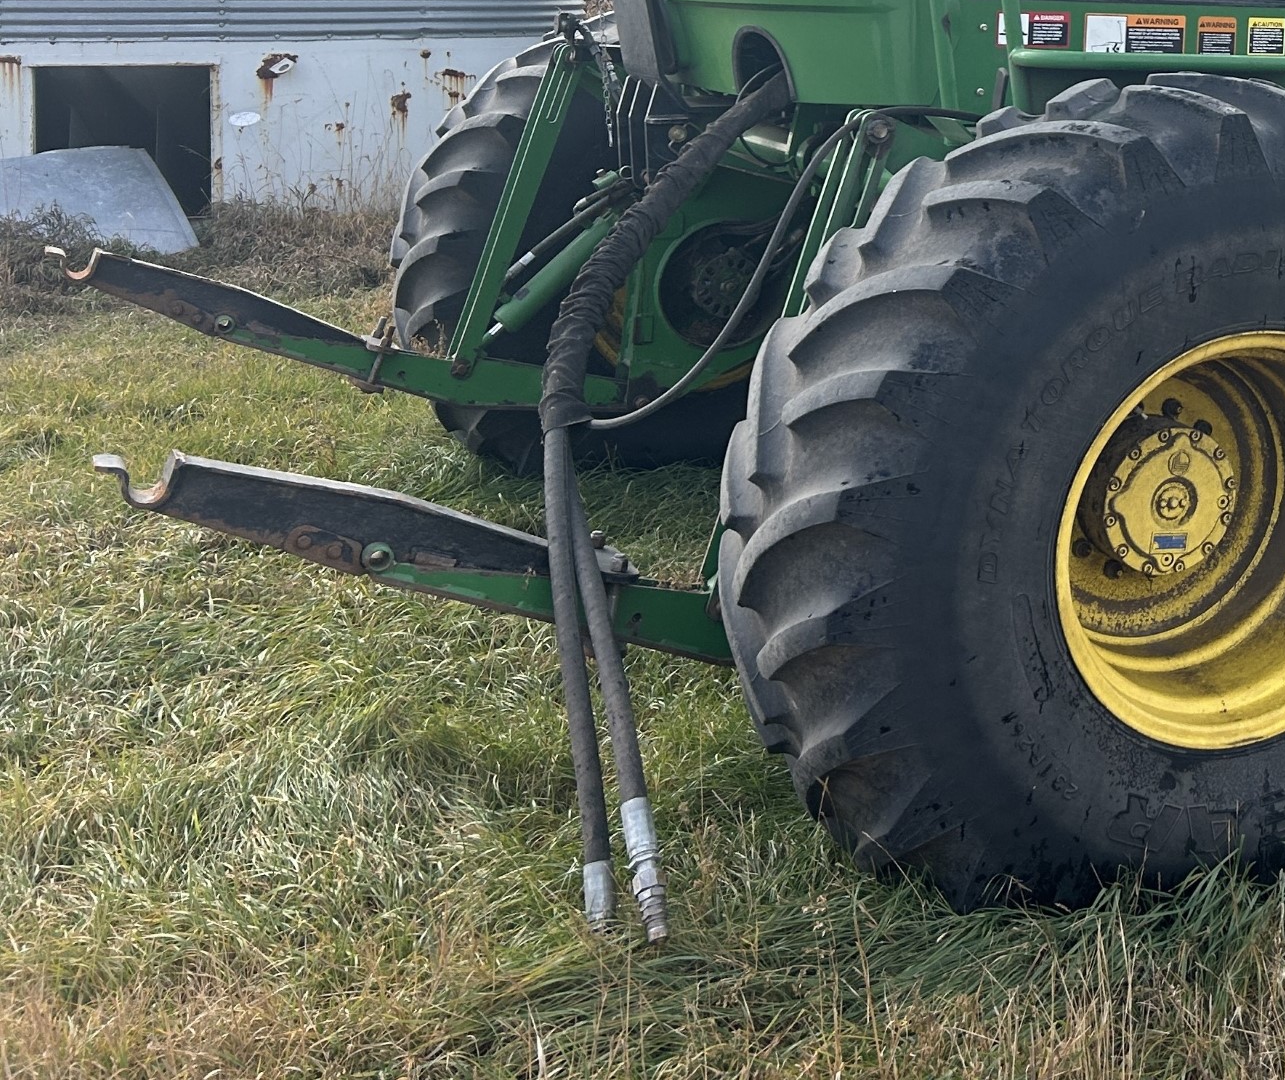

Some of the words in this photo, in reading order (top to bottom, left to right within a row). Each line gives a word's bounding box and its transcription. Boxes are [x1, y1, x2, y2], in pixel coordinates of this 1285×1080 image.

[1143, 18, 1179, 26] WARNING
[1205, 21, 1236, 29] WARNING
[1022, 283, 1165, 434] TORQUE
